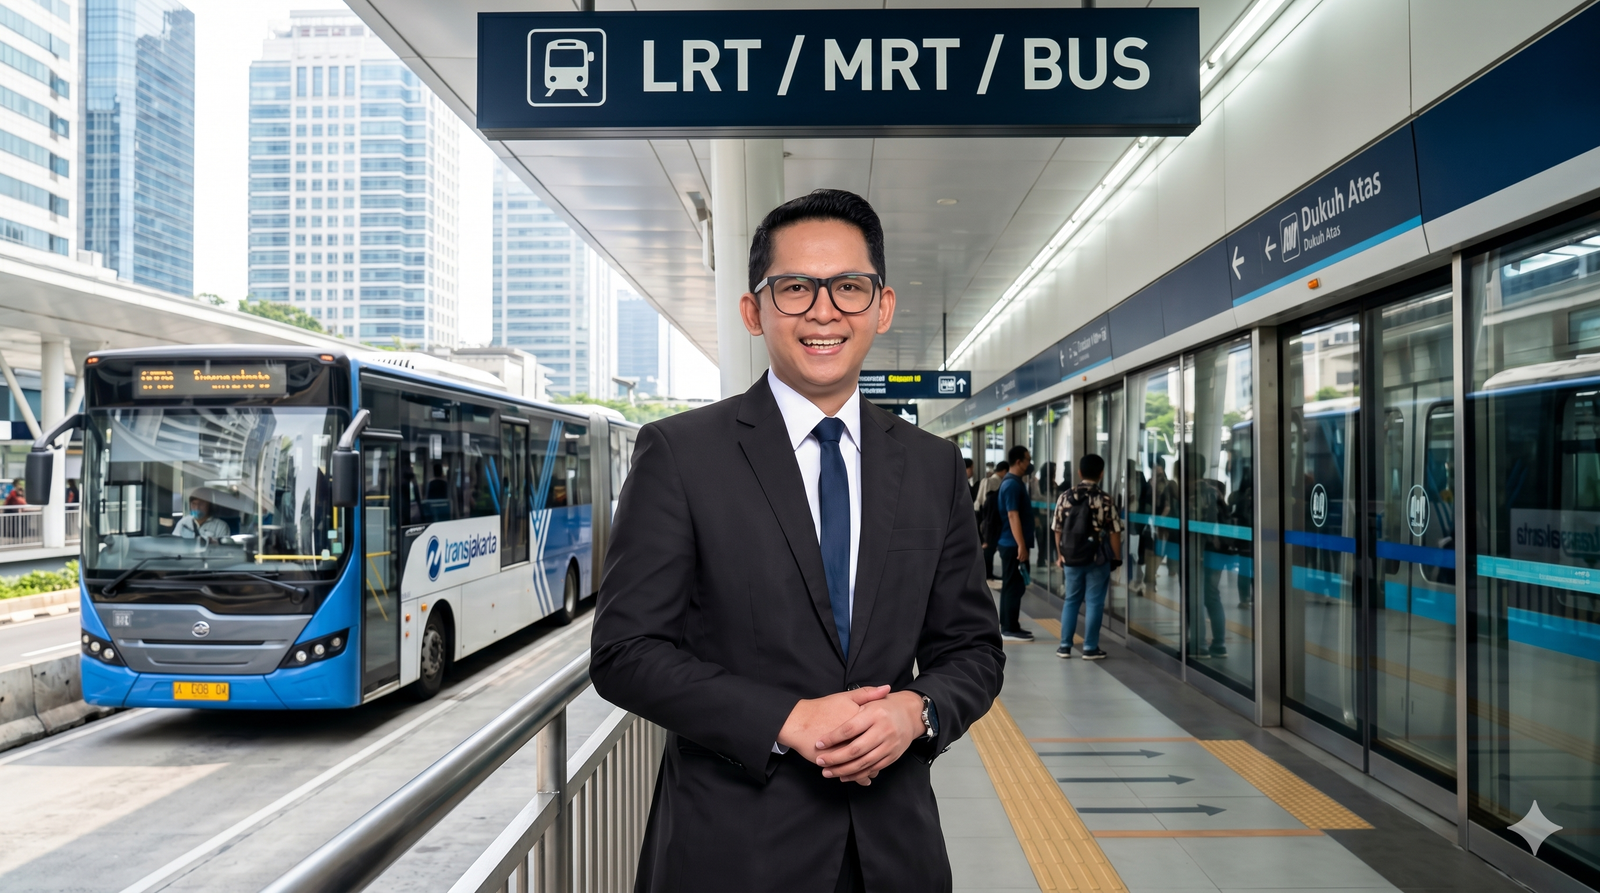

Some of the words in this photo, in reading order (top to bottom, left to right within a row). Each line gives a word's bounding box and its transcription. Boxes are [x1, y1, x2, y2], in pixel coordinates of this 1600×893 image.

[643, 39, 762, 92] LRT
[776, 34, 805, 96] /
[824, 38, 960, 91] MRT
[976, 33, 1004, 95] /
[1023, 36, 1150, 90] BUS
[1301, 186, 1345, 232] Dukuh
[1348, 171, 1382, 209] Atas
[1303, 230, 1325, 252] Dukuh
[1325, 225, 1341, 242] Atas
[444, 531, 498, 568] transjakarta
